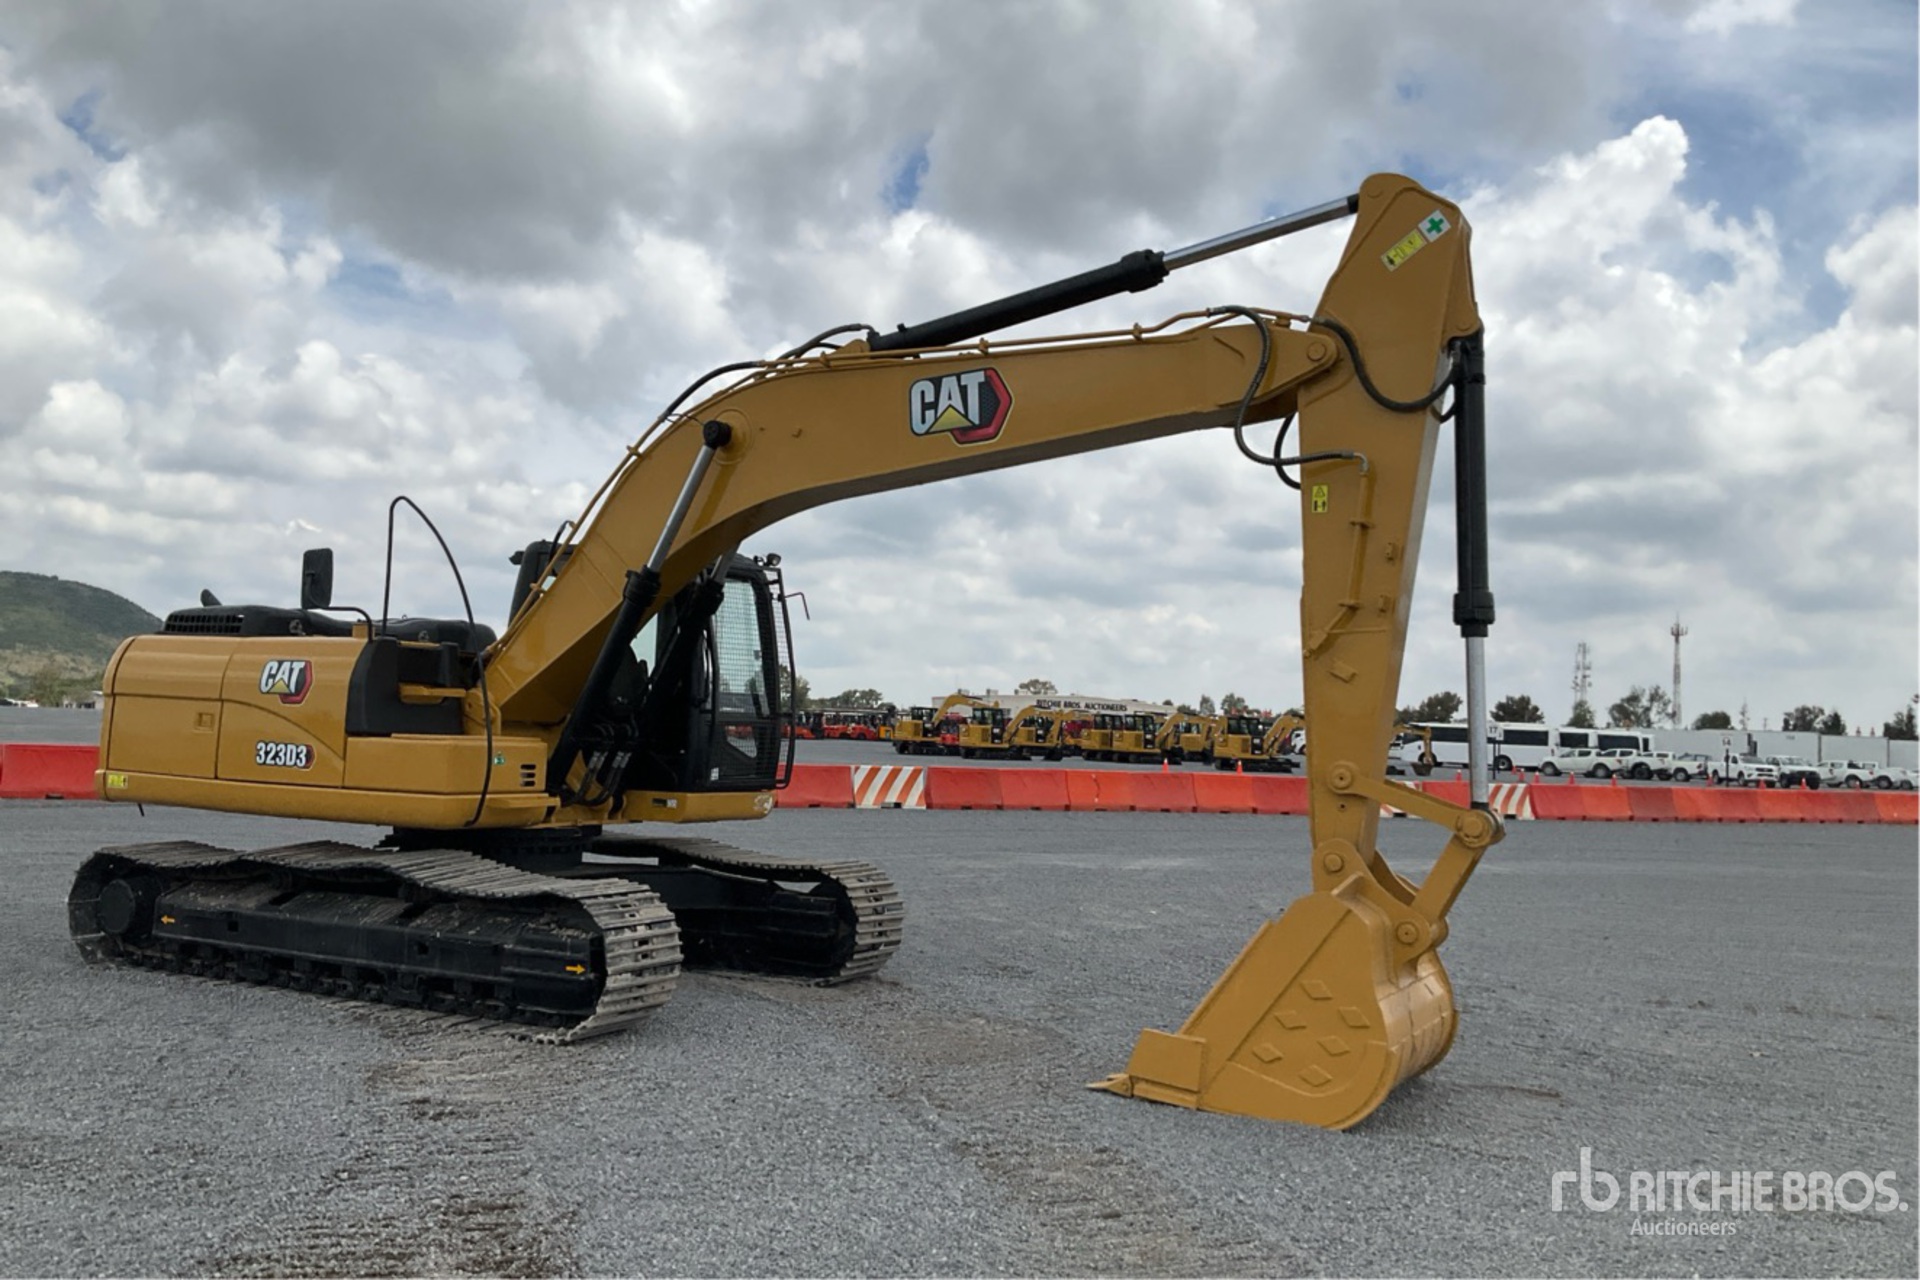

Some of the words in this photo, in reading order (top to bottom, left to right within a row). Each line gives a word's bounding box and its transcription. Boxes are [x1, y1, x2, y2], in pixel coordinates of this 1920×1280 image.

[910, 370, 985, 435] CAT
[260, 660, 306, 693] CAT
[1084, 702, 1128, 711] AUCTIONEERS
[256, 741, 307, 767] 323D3
